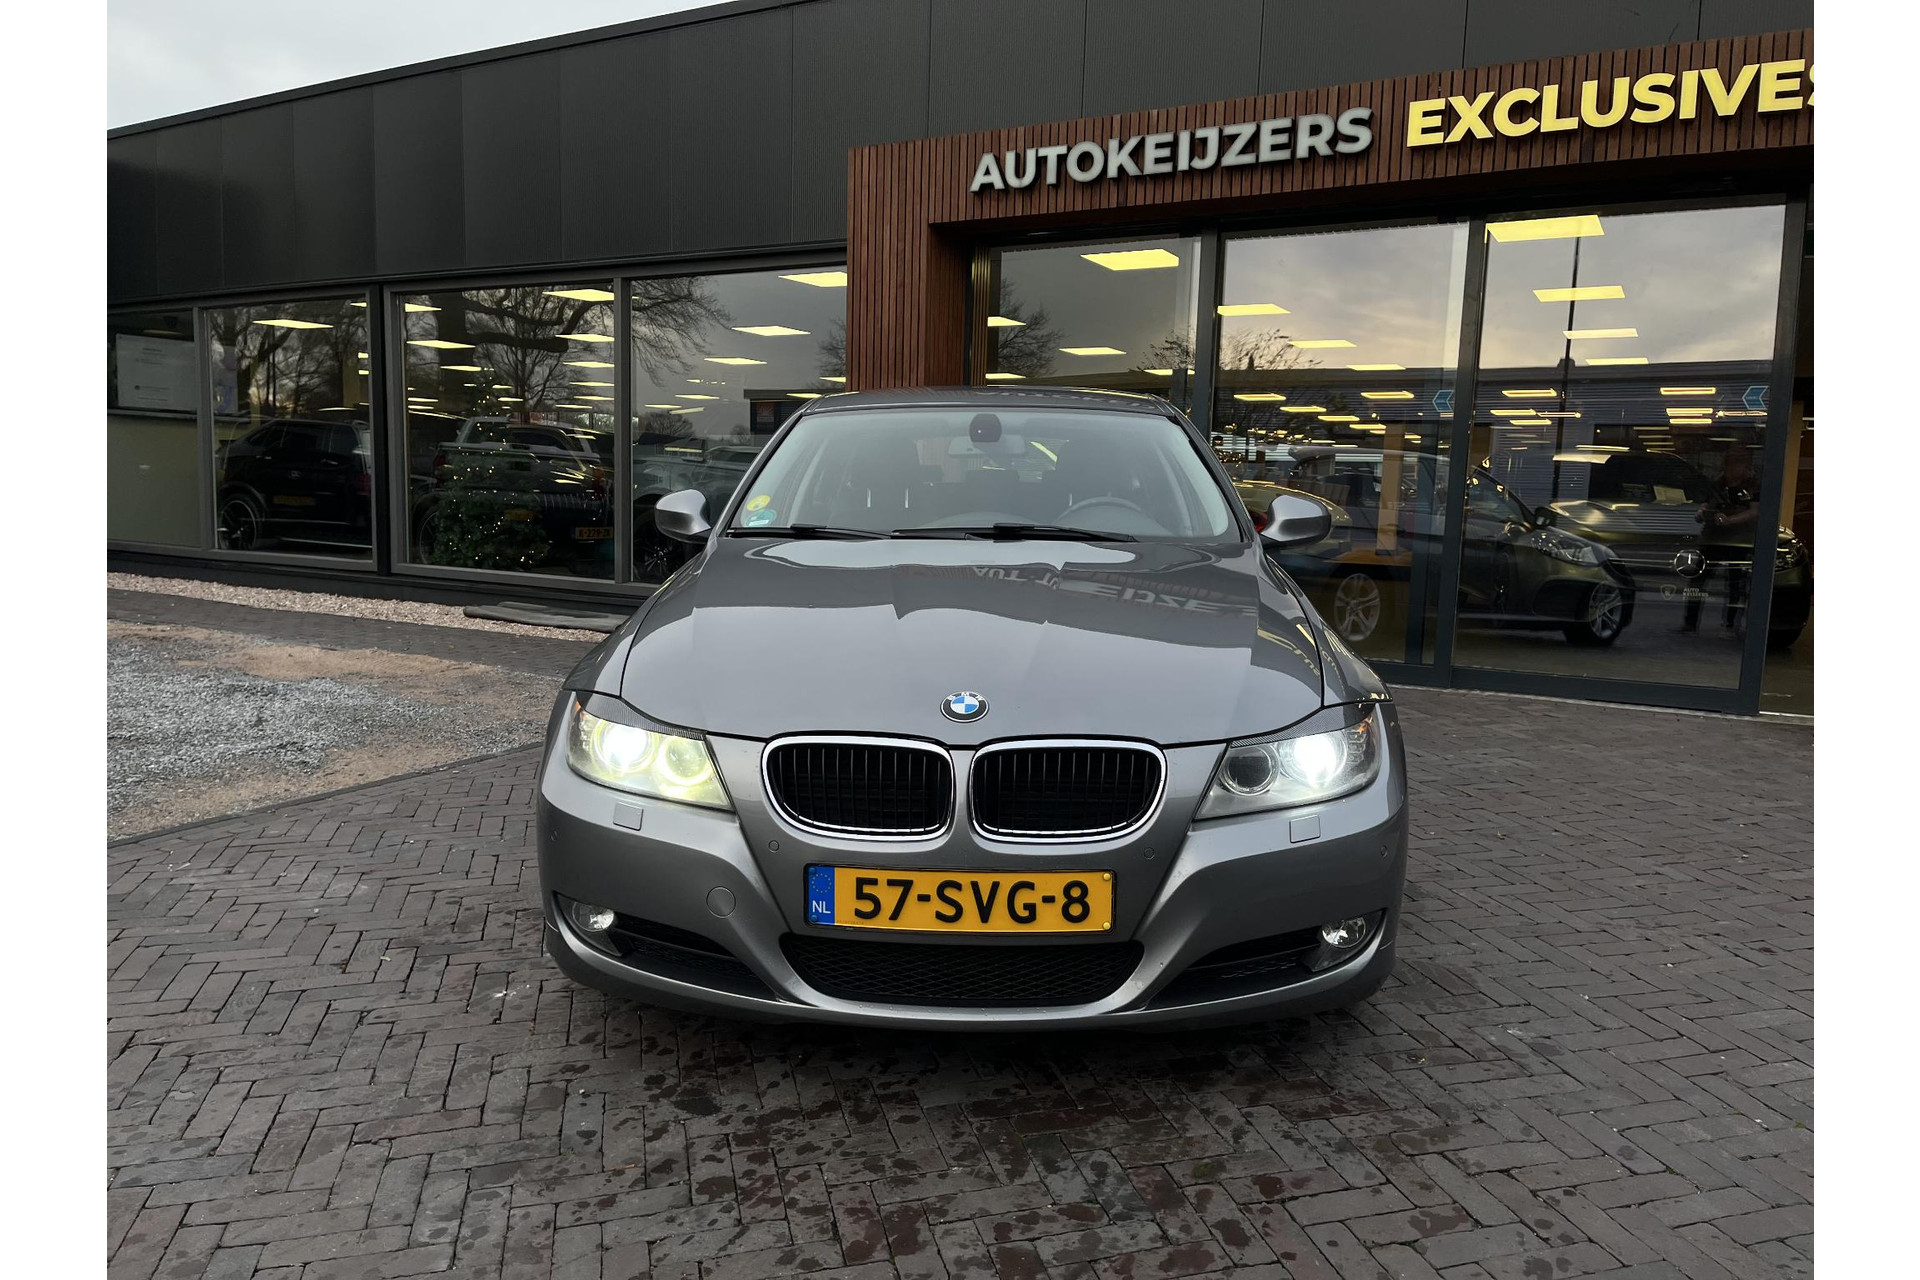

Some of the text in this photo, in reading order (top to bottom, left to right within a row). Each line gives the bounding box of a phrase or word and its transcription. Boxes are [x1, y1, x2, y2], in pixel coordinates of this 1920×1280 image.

[970, 59, 1814, 192] AUTOKEIJZERS EXCLUSIVE
[812, 877, 1091, 924] NL 57-SVG-8
